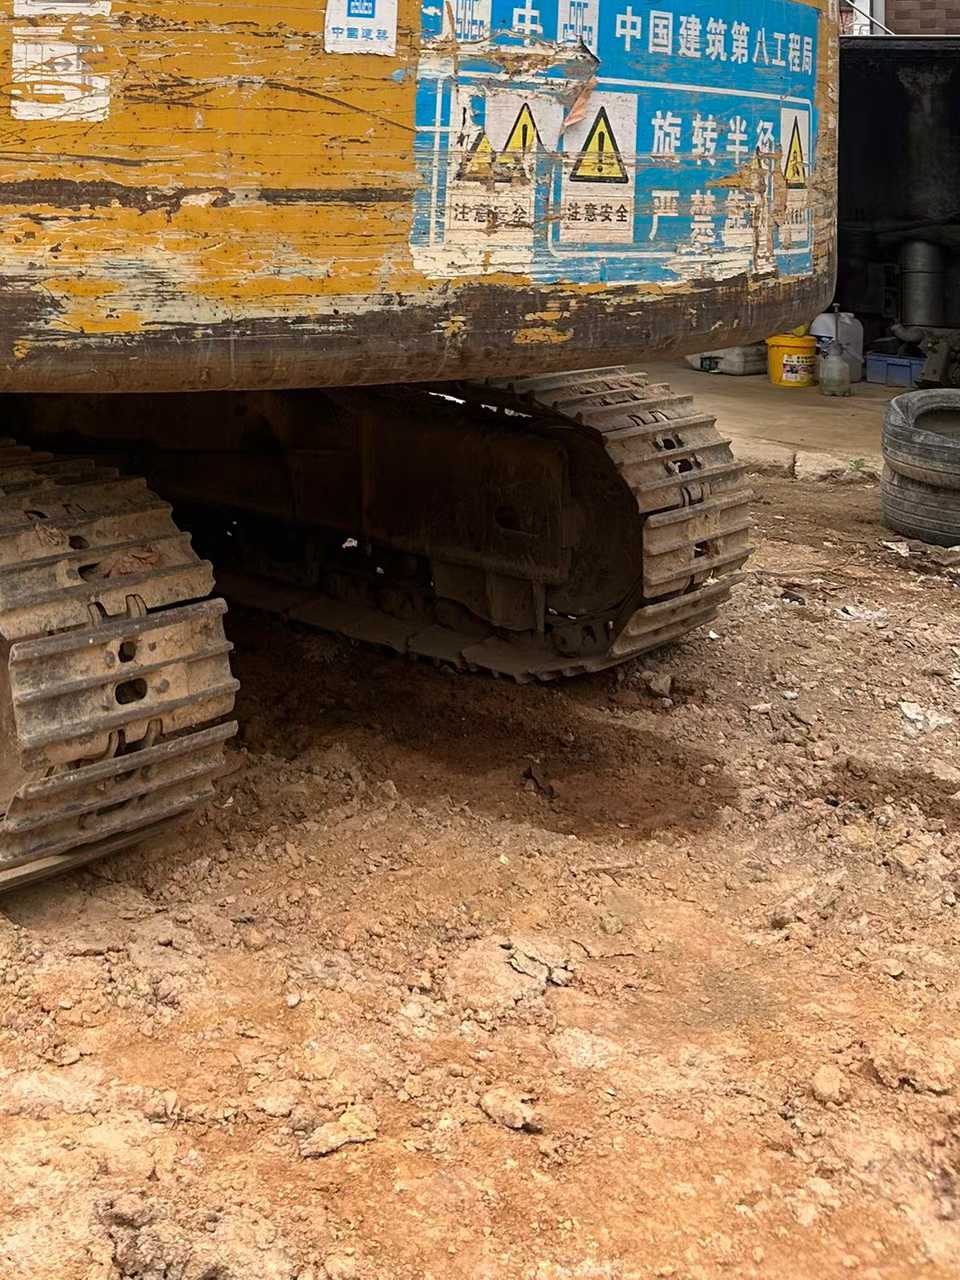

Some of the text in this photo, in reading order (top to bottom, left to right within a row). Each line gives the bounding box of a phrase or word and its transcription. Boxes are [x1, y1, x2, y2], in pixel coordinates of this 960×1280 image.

[615, 5, 813, 76] 中国建筑第八工程局
[567, 202, 629, 224] 注意安全
